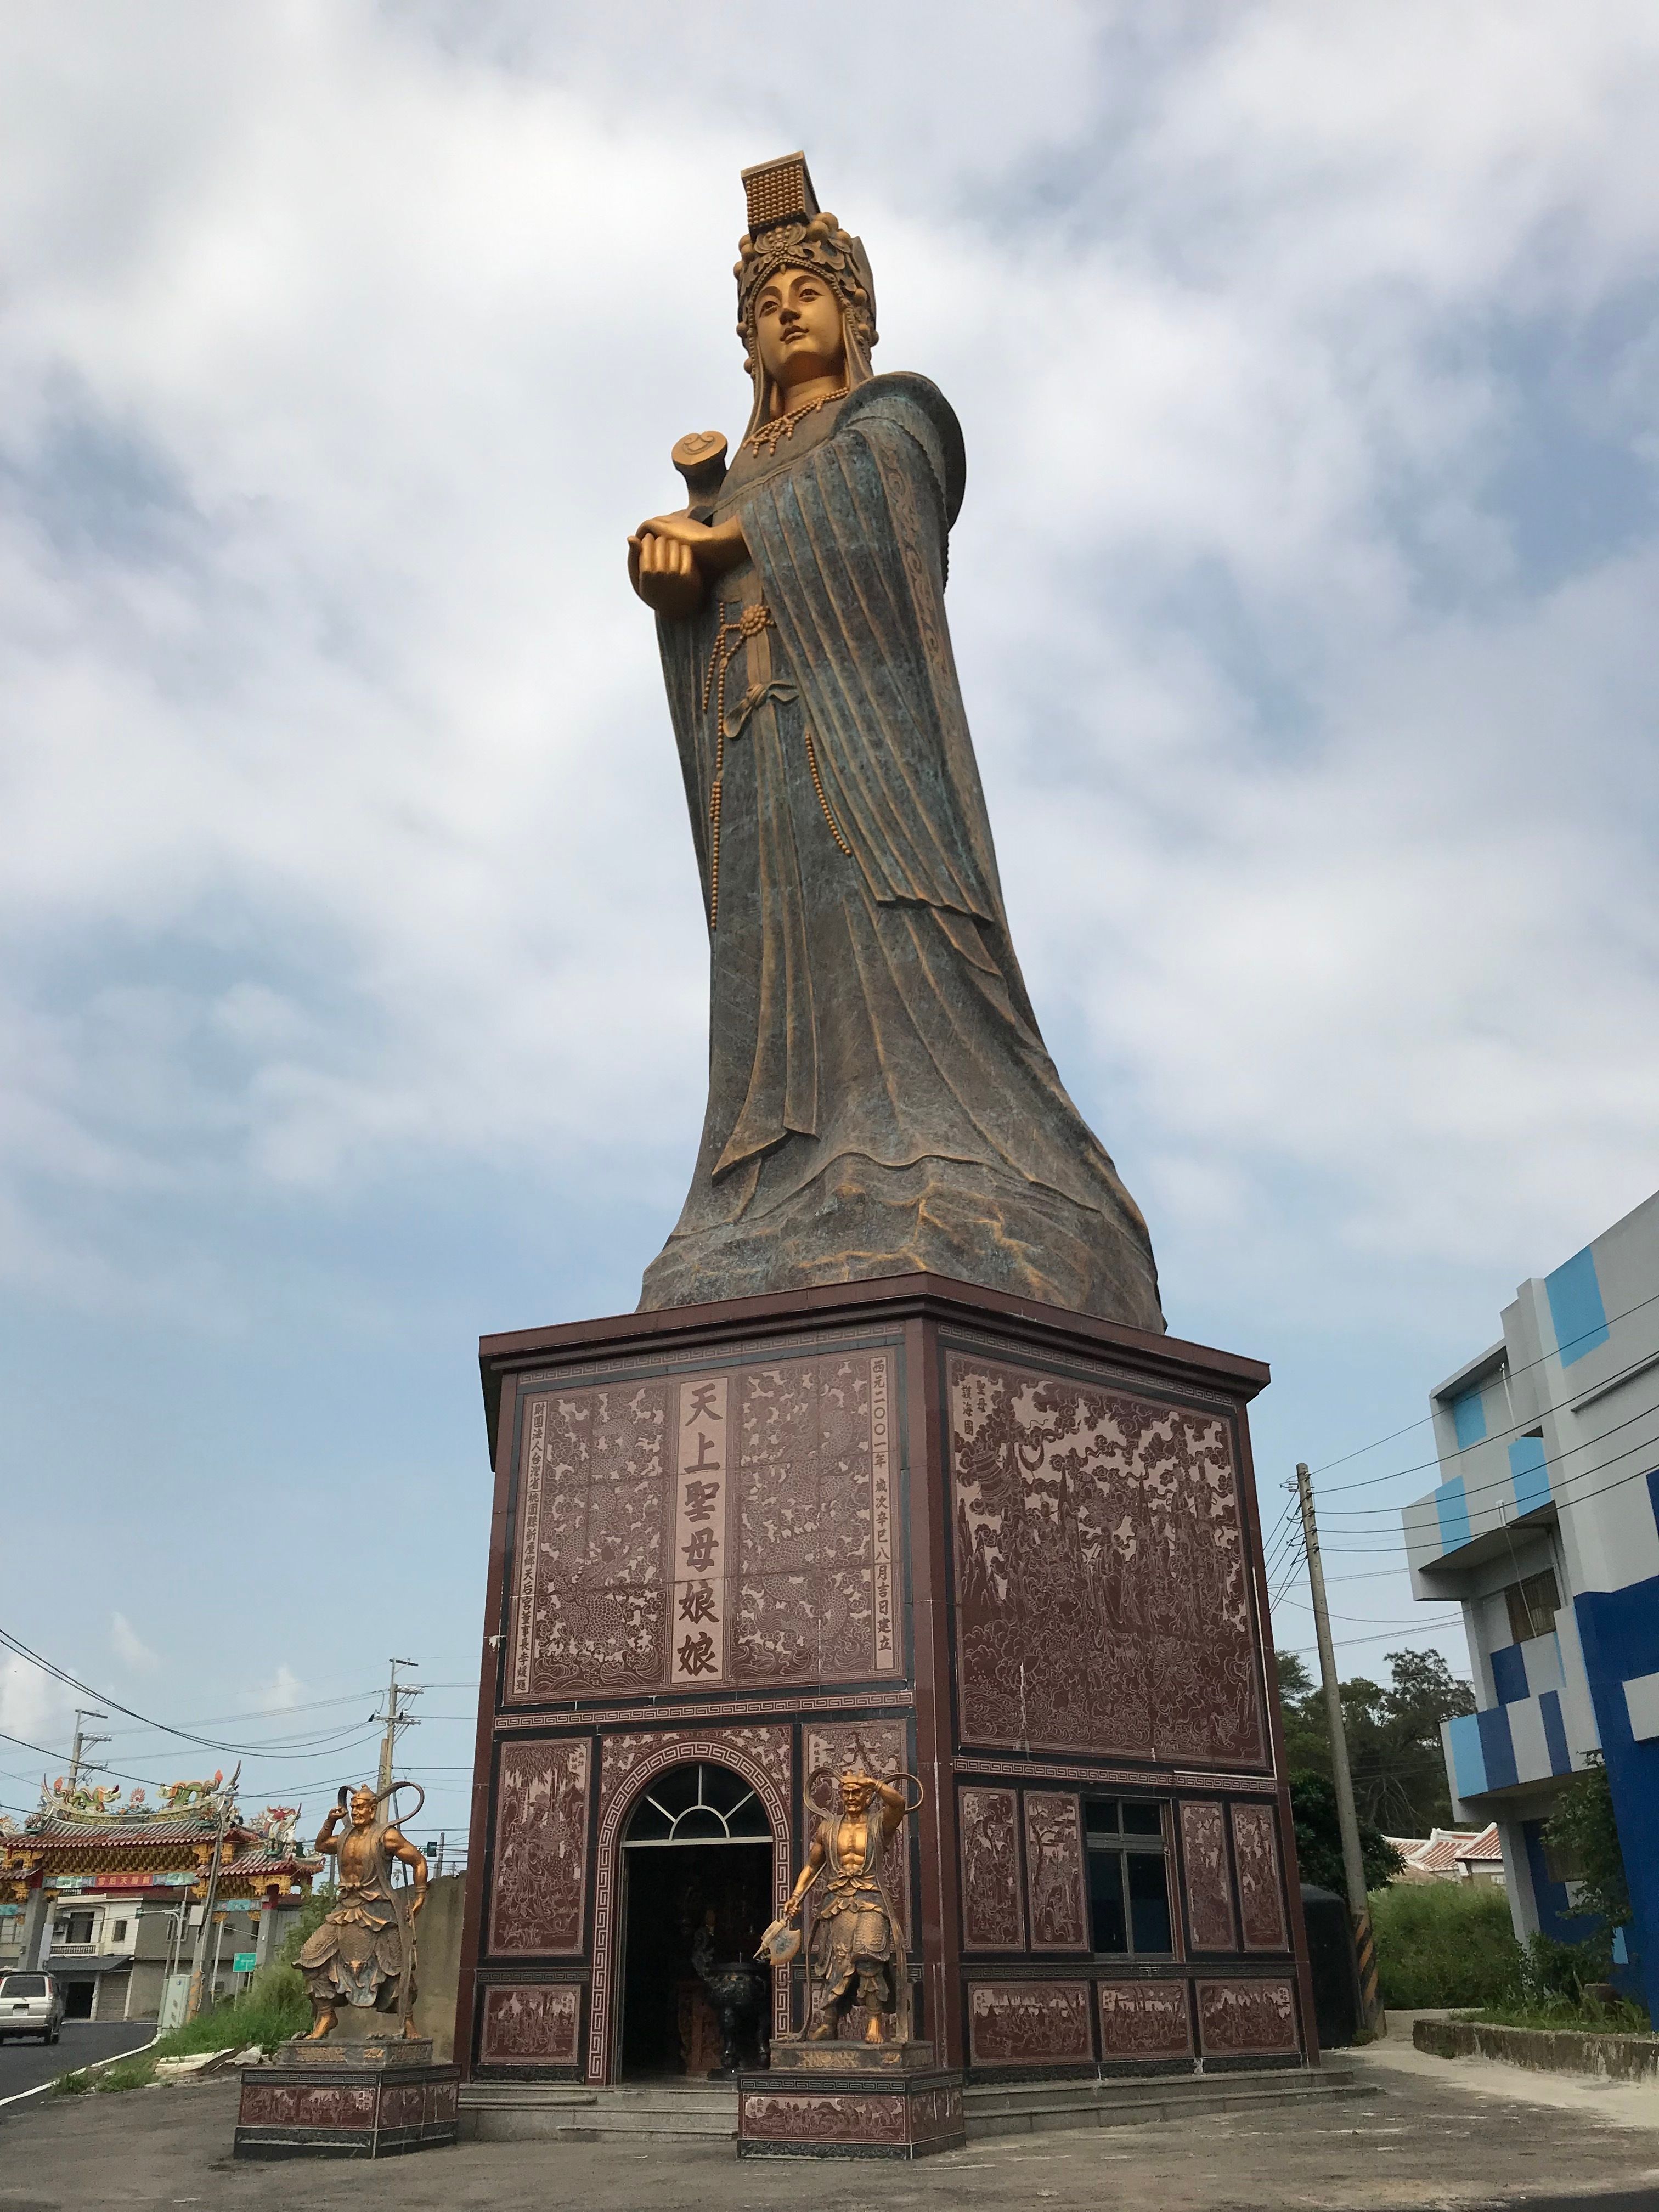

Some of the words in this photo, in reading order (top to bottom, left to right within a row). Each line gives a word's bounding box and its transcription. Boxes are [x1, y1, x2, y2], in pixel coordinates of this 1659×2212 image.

[677, 1383, 723, 1676] 天上聖母娘娘
